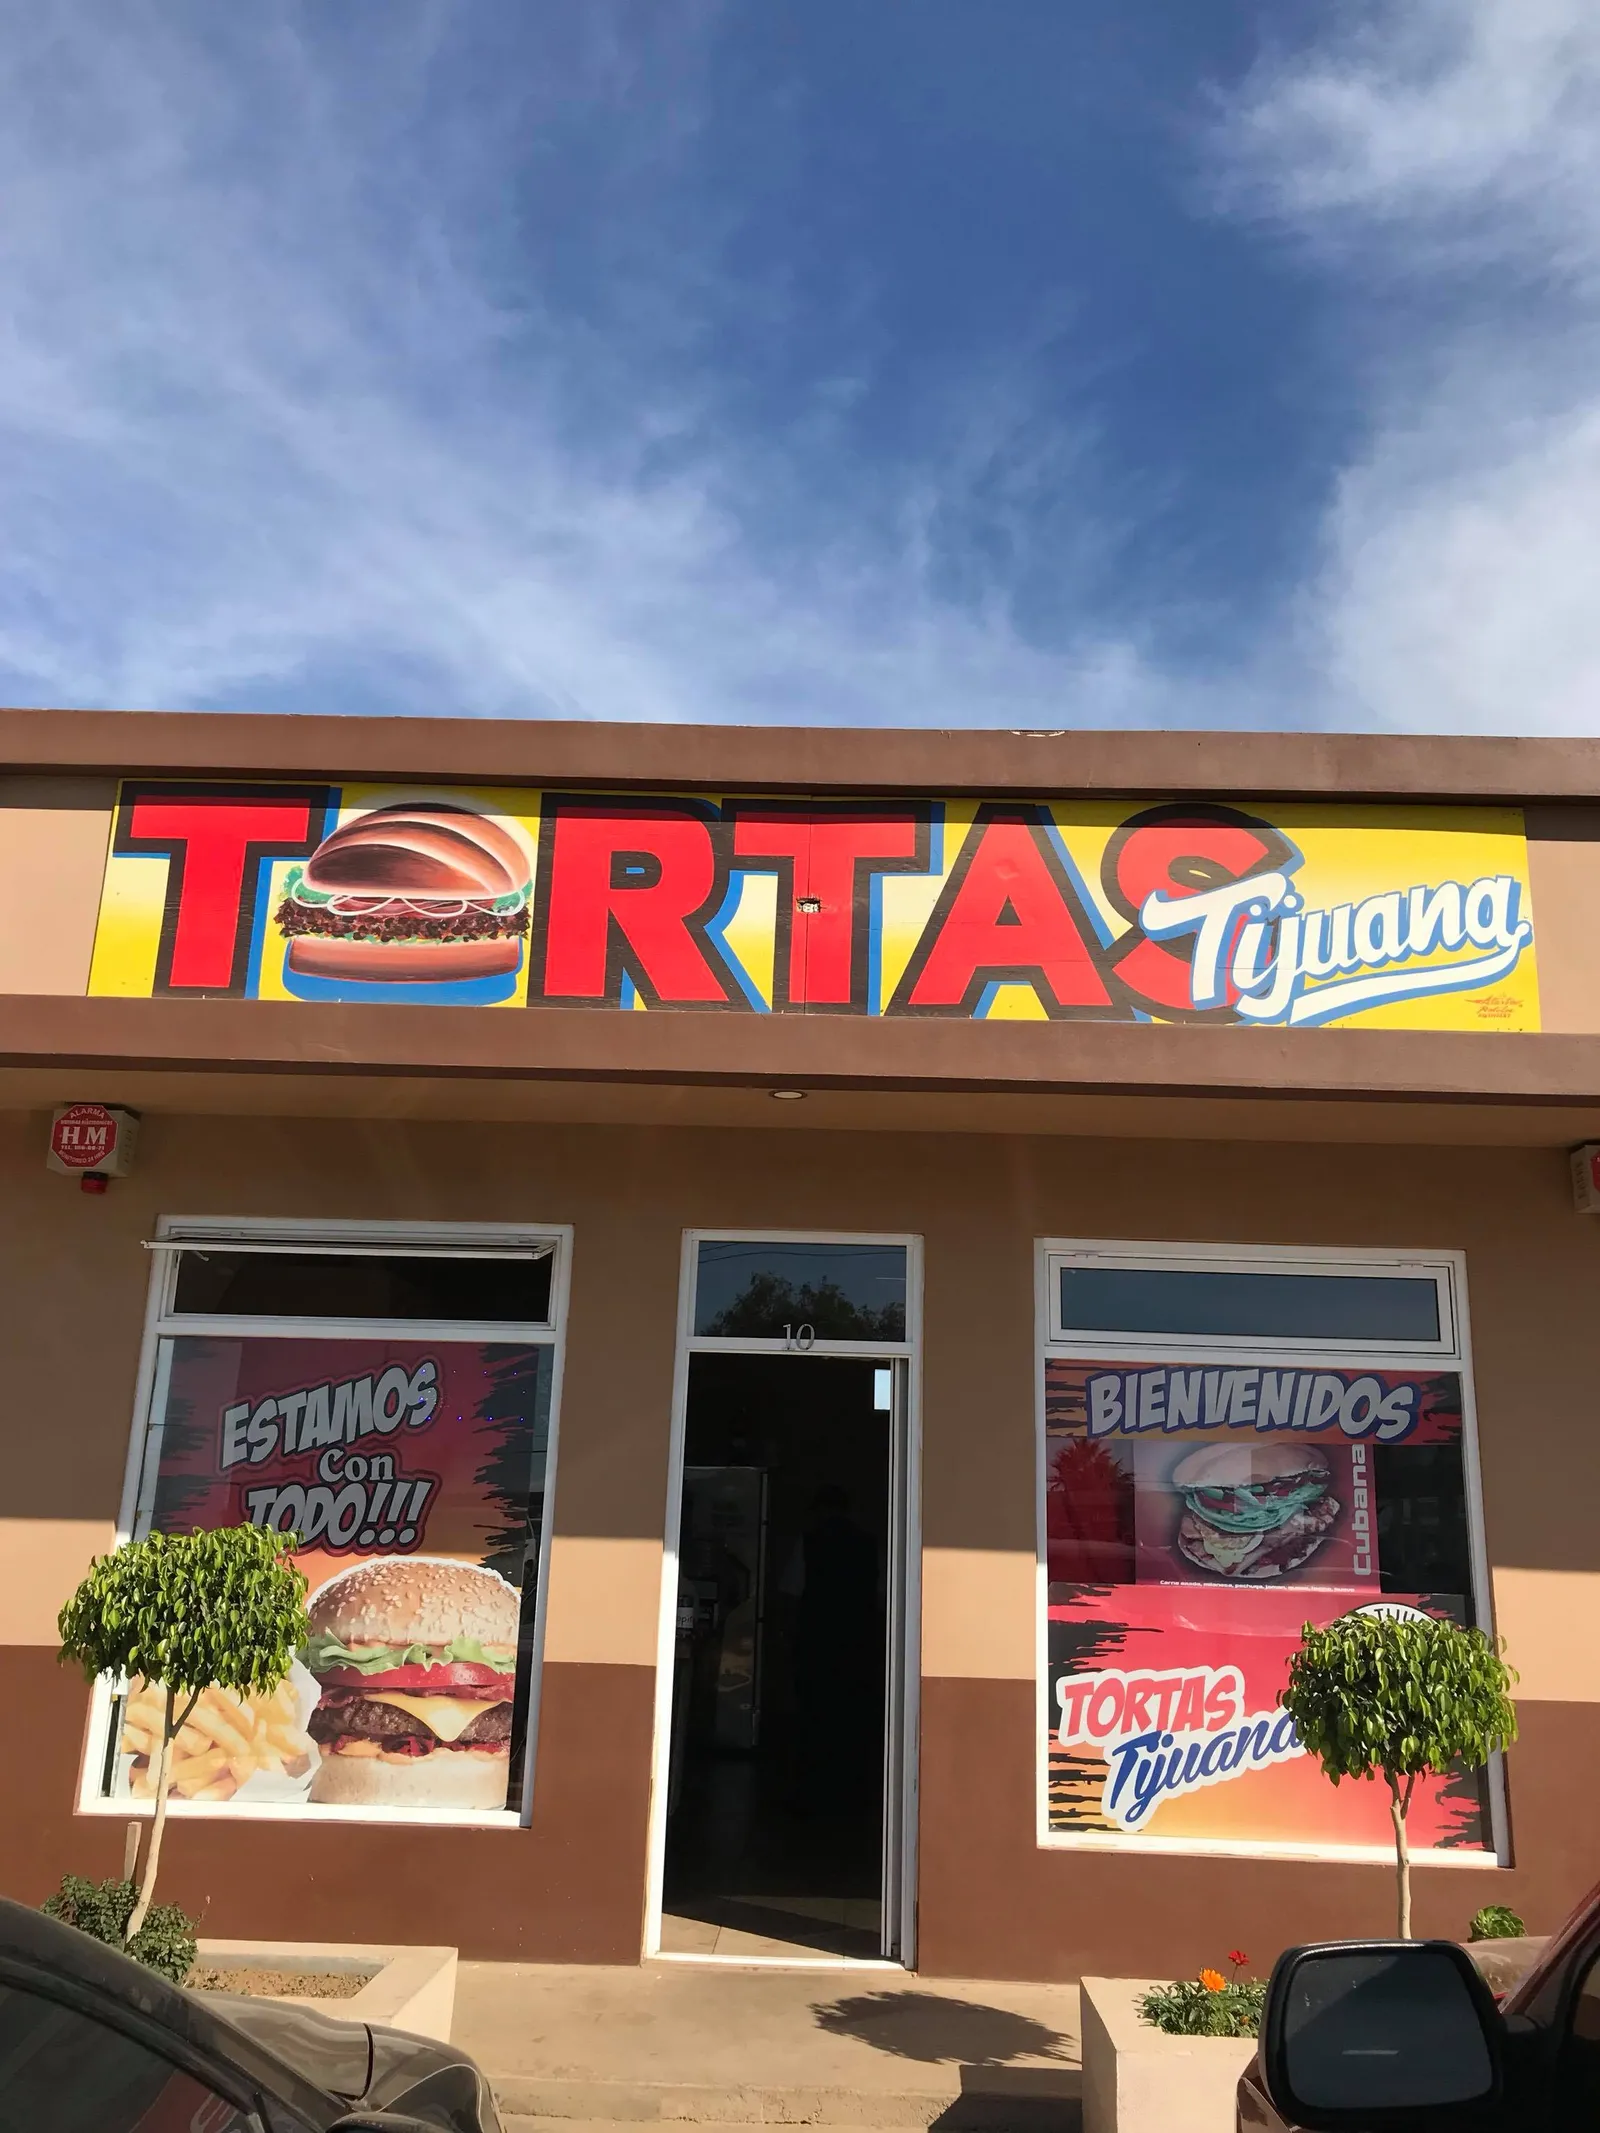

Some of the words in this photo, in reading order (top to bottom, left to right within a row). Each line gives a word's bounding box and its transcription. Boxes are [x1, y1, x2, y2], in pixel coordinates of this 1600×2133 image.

[1141, 873, 1532, 1025] Tijuana
[70, 1107, 104, 1118] ALARMA
[782, 1323, 815, 1351] 10
[221, 1361, 438, 1470] ESTAMOS
[1088, 1368, 1415, 1439] BIENVENIDOS
[319, 1448, 394, 1483] Con
[247, 1480, 433, 1548] TODO!!!
[1063, 1673, 1237, 1738] TORTAS
[1108, 1711, 1302, 1823] Tijuana
